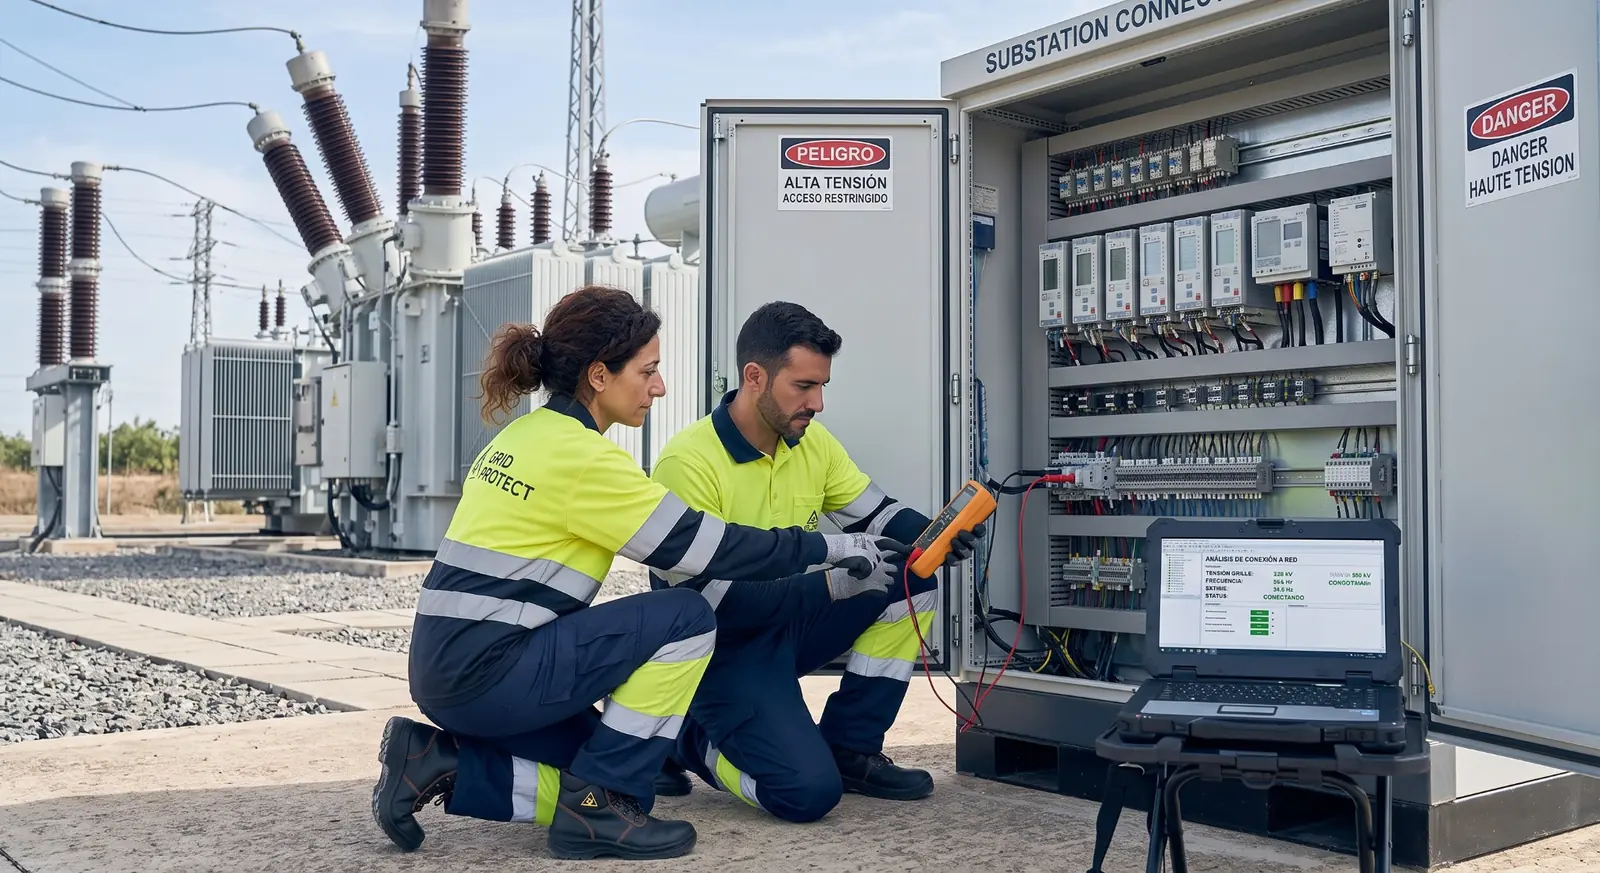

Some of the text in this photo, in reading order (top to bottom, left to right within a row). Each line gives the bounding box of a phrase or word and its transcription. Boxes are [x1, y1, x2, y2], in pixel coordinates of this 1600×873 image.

[985, 0, 1222, 74] SUBSTATION CONNE
[1482, 93, 1557, 135] DANGER
[797, 147, 874, 161] PELIGRO
[1492, 135, 1548, 169] DANGER
[784, 174, 887, 189] ALTA TENSIÓN
[1469, 152, 1574, 199] HAUTE TENSION
[782, 193, 888, 203] ACCESO RESTRINGIDO
[488, 451, 514, 469] GRID
[478, 466, 535, 500] PROTECT
